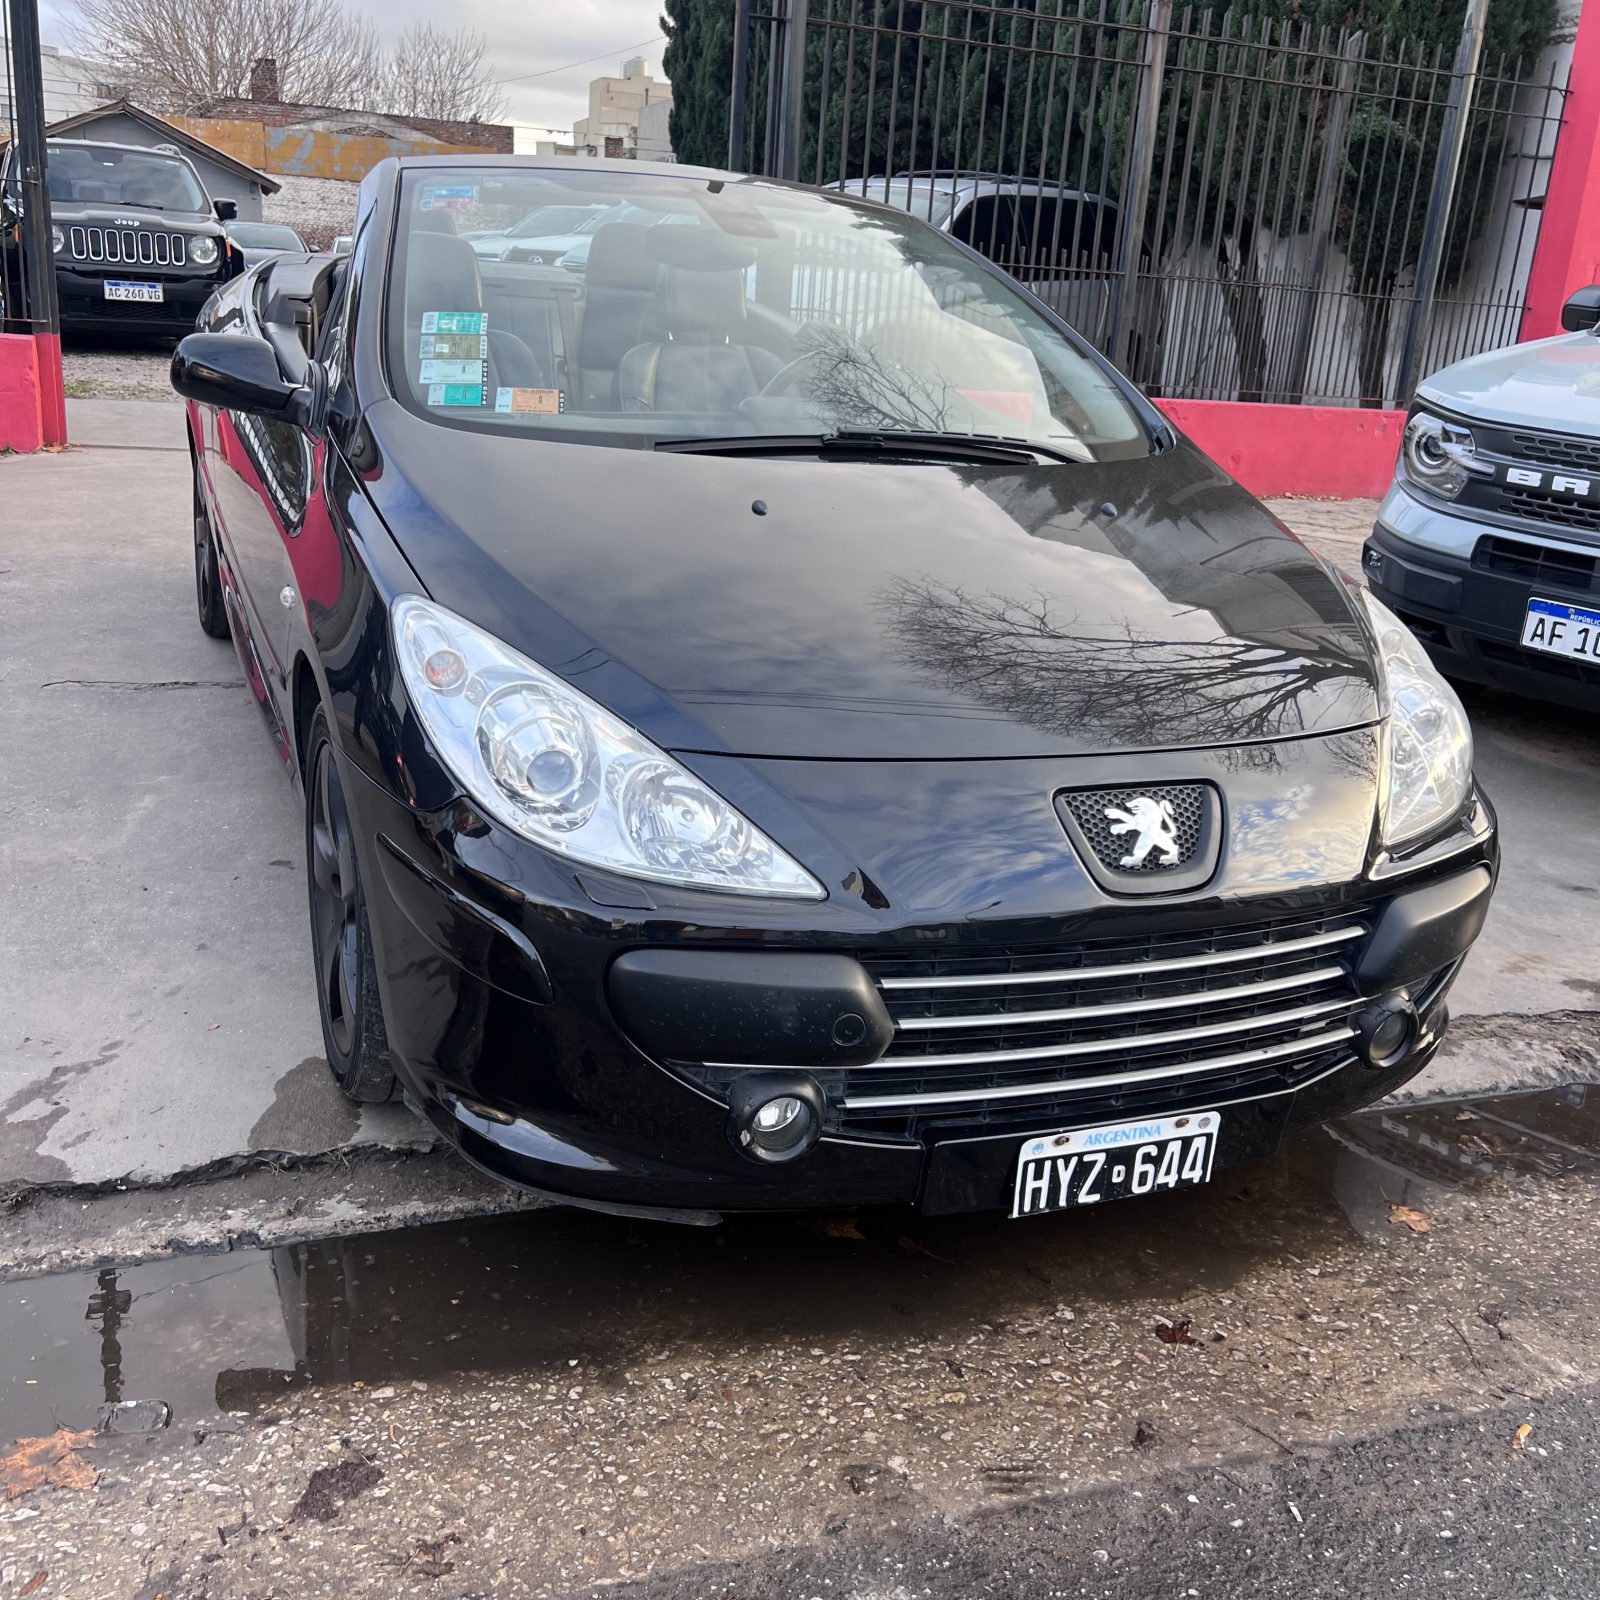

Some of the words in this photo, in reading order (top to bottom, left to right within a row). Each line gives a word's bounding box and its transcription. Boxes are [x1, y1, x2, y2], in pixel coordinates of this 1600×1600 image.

[114, 219, 140, 227] Jeep
[108, 287, 121, 298] AC
[124, 288, 145, 300] 260
[147, 290, 161, 300] VG
[1506, 467, 1591, 496] BR
[1529, 616, 1567, 646] AF
[1083, 1124, 1162, 1147] ARGENTINA
[1023, 1152, 1107, 1213] HYZ
[1130, 1136, 1207, 1195] 644
